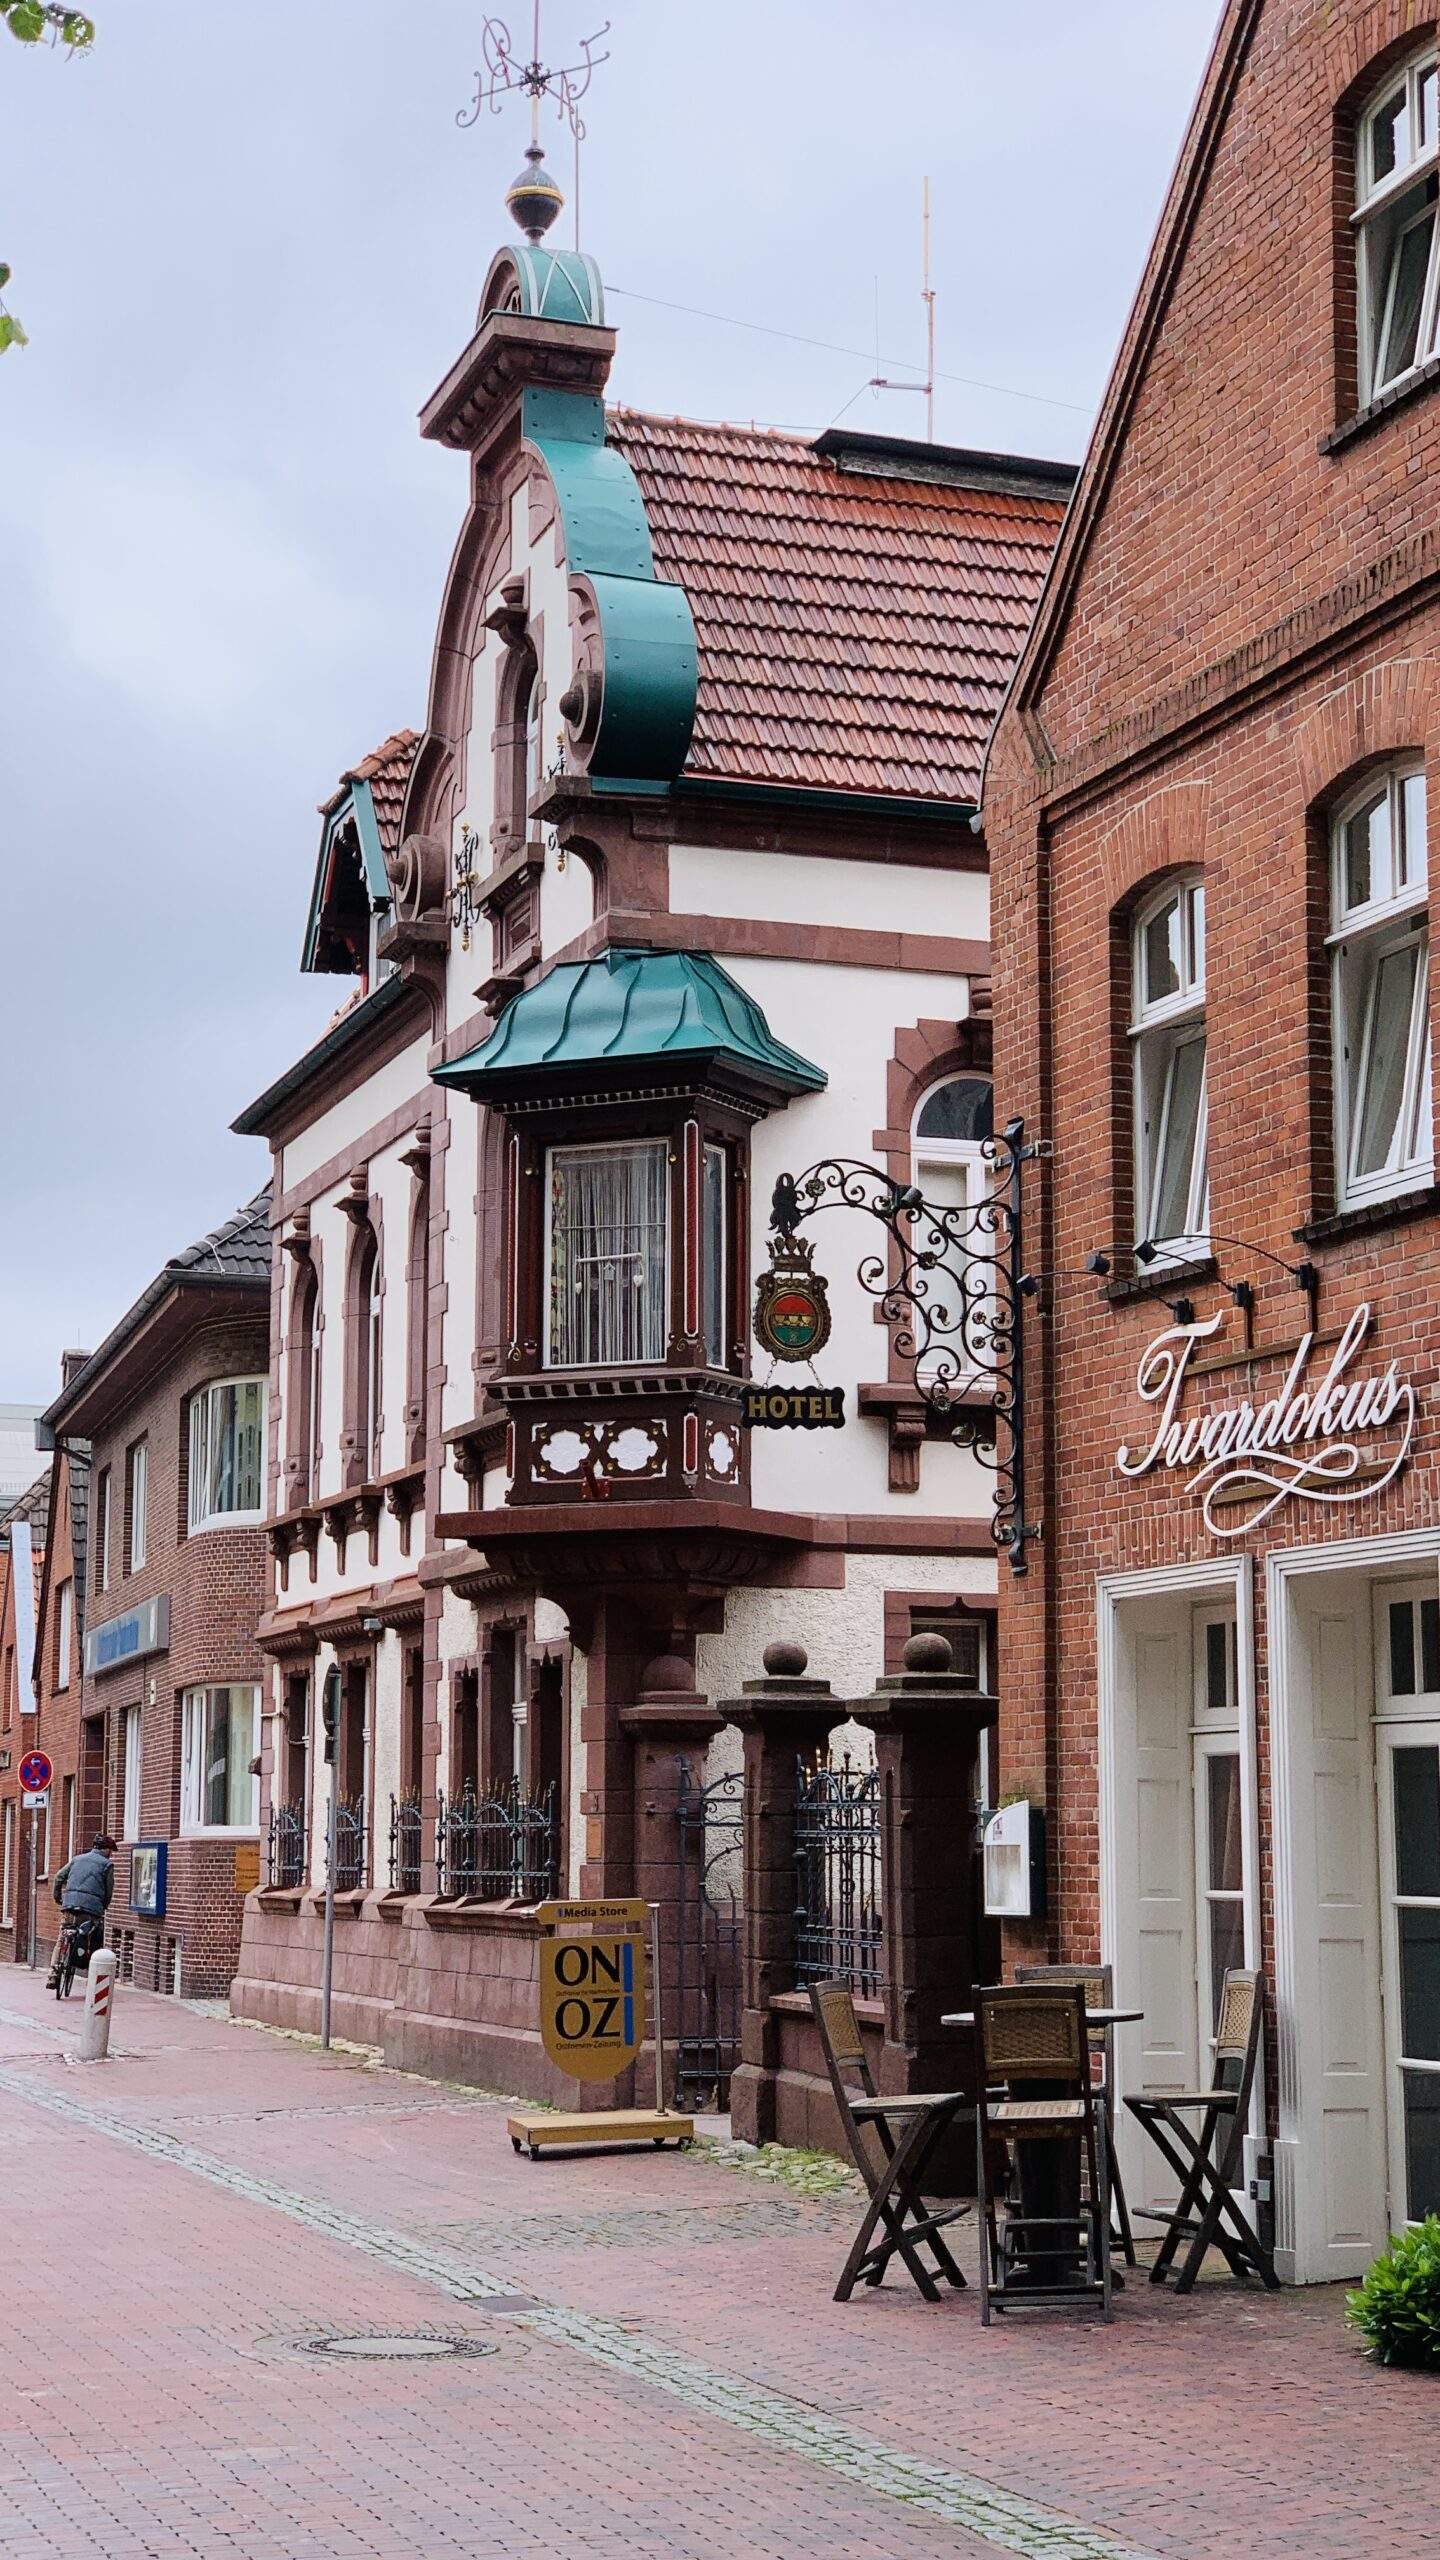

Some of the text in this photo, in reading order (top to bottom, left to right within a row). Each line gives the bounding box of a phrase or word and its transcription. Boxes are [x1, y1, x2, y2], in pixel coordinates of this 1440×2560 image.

[748, 1395, 840, 1419] HOTEL
[1117, 1302, 1414, 1537] Twardokus
[564, 1906, 628, 1918] Media Store
[554, 1944, 621, 1987] ON
[555, 1996, 621, 2041] OZ
